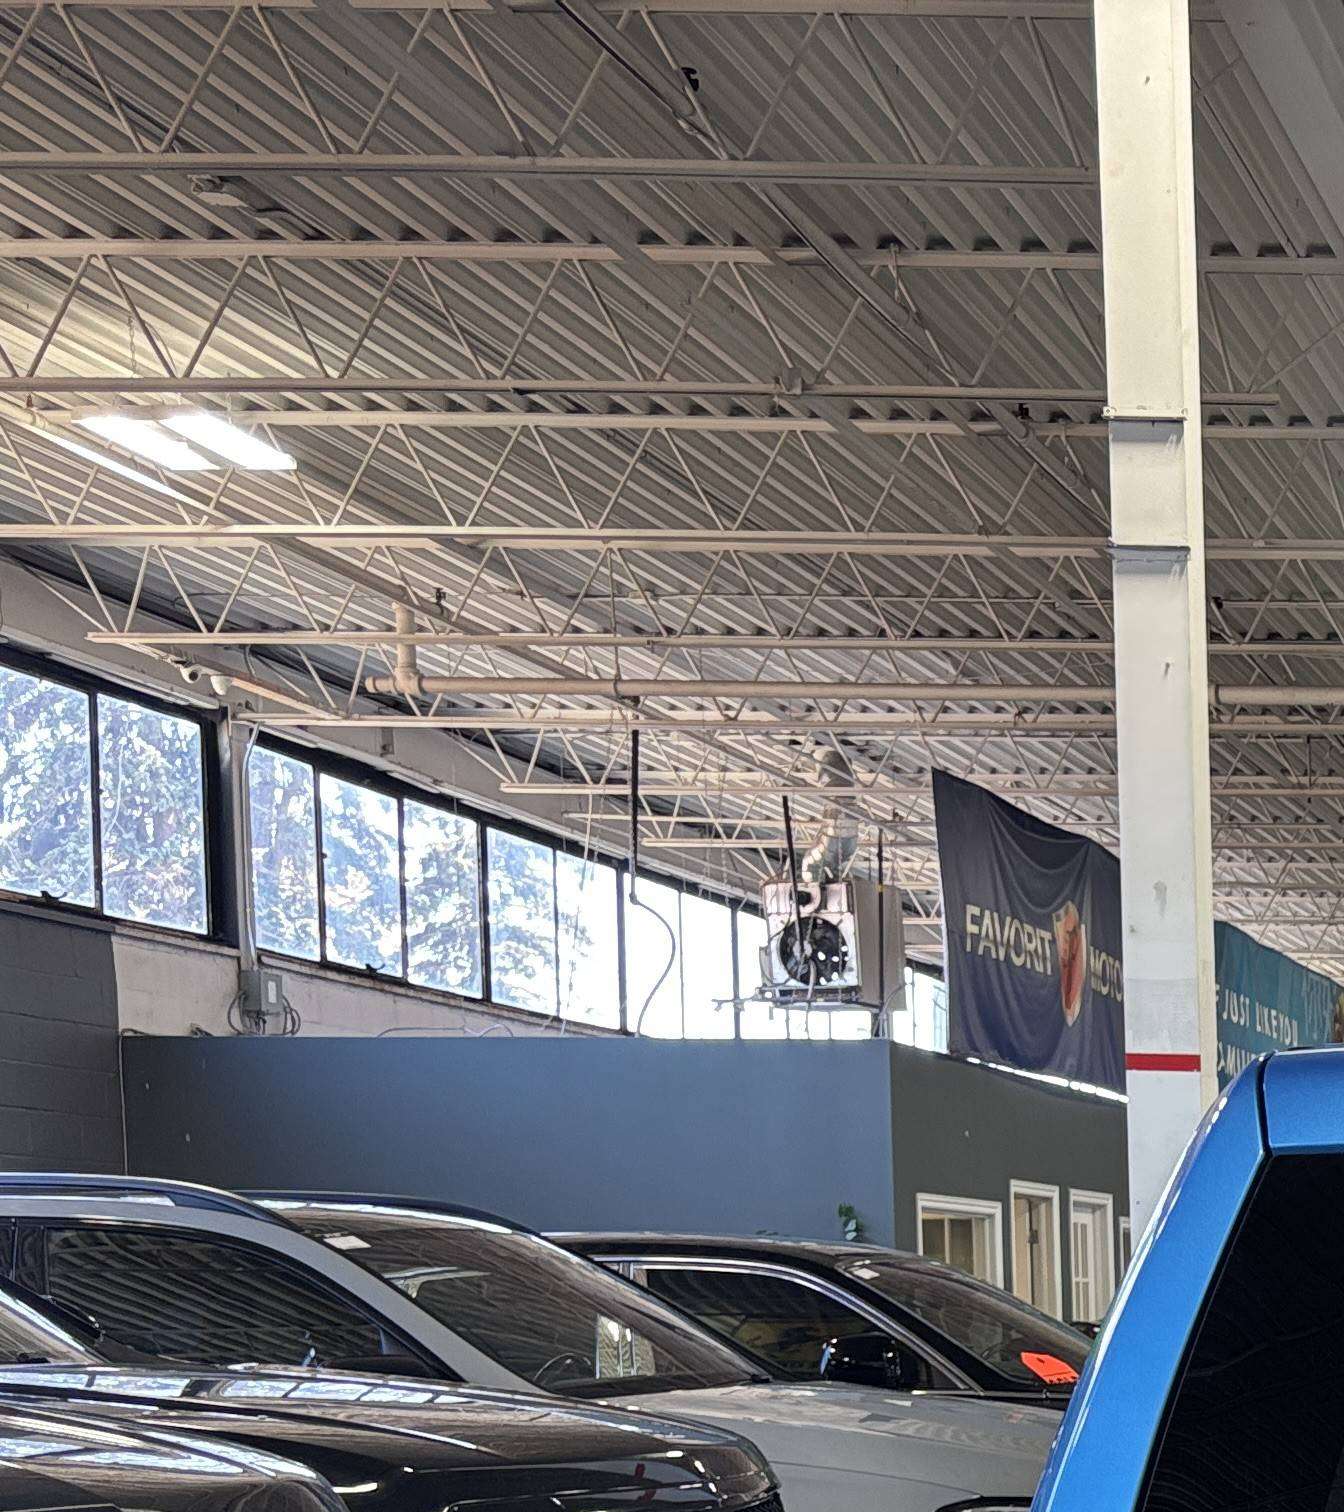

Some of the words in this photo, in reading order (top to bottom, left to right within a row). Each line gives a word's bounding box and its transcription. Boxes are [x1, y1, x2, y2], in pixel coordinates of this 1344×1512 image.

[964, 904, 1057, 976] FAVORIT
[1090, 945, 1123, 1003] MOTO
[1222, 988, 1250, 1027] JUST
[1256, 1001, 1278, 1039] LIKE
